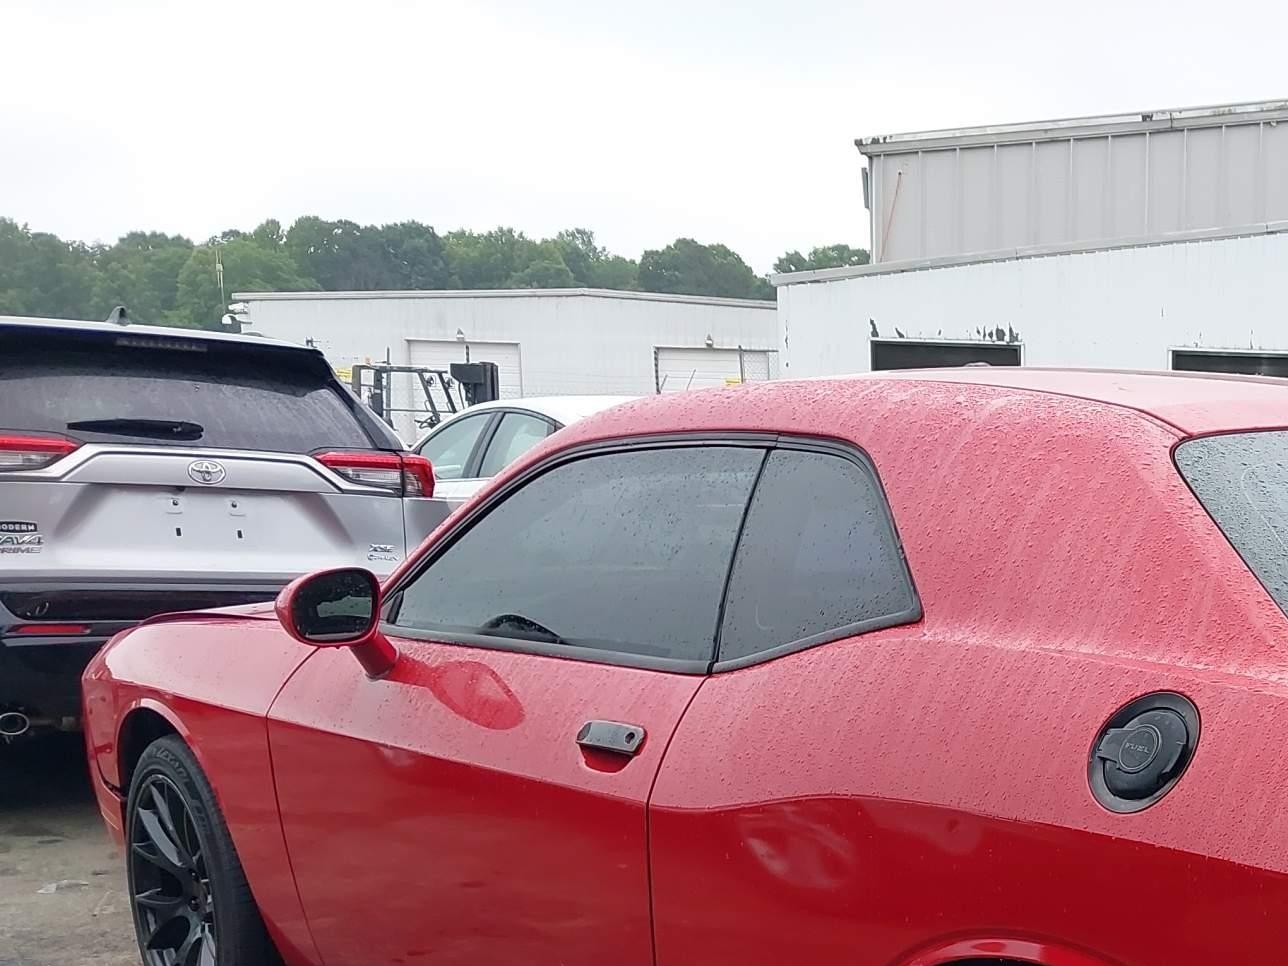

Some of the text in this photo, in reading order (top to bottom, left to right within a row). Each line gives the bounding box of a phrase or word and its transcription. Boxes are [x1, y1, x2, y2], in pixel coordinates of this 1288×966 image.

[0, 523, 35, 531] ODERN
[0, 534, 44, 545] AV4
[1124, 741, 1151, 754] FUEL
